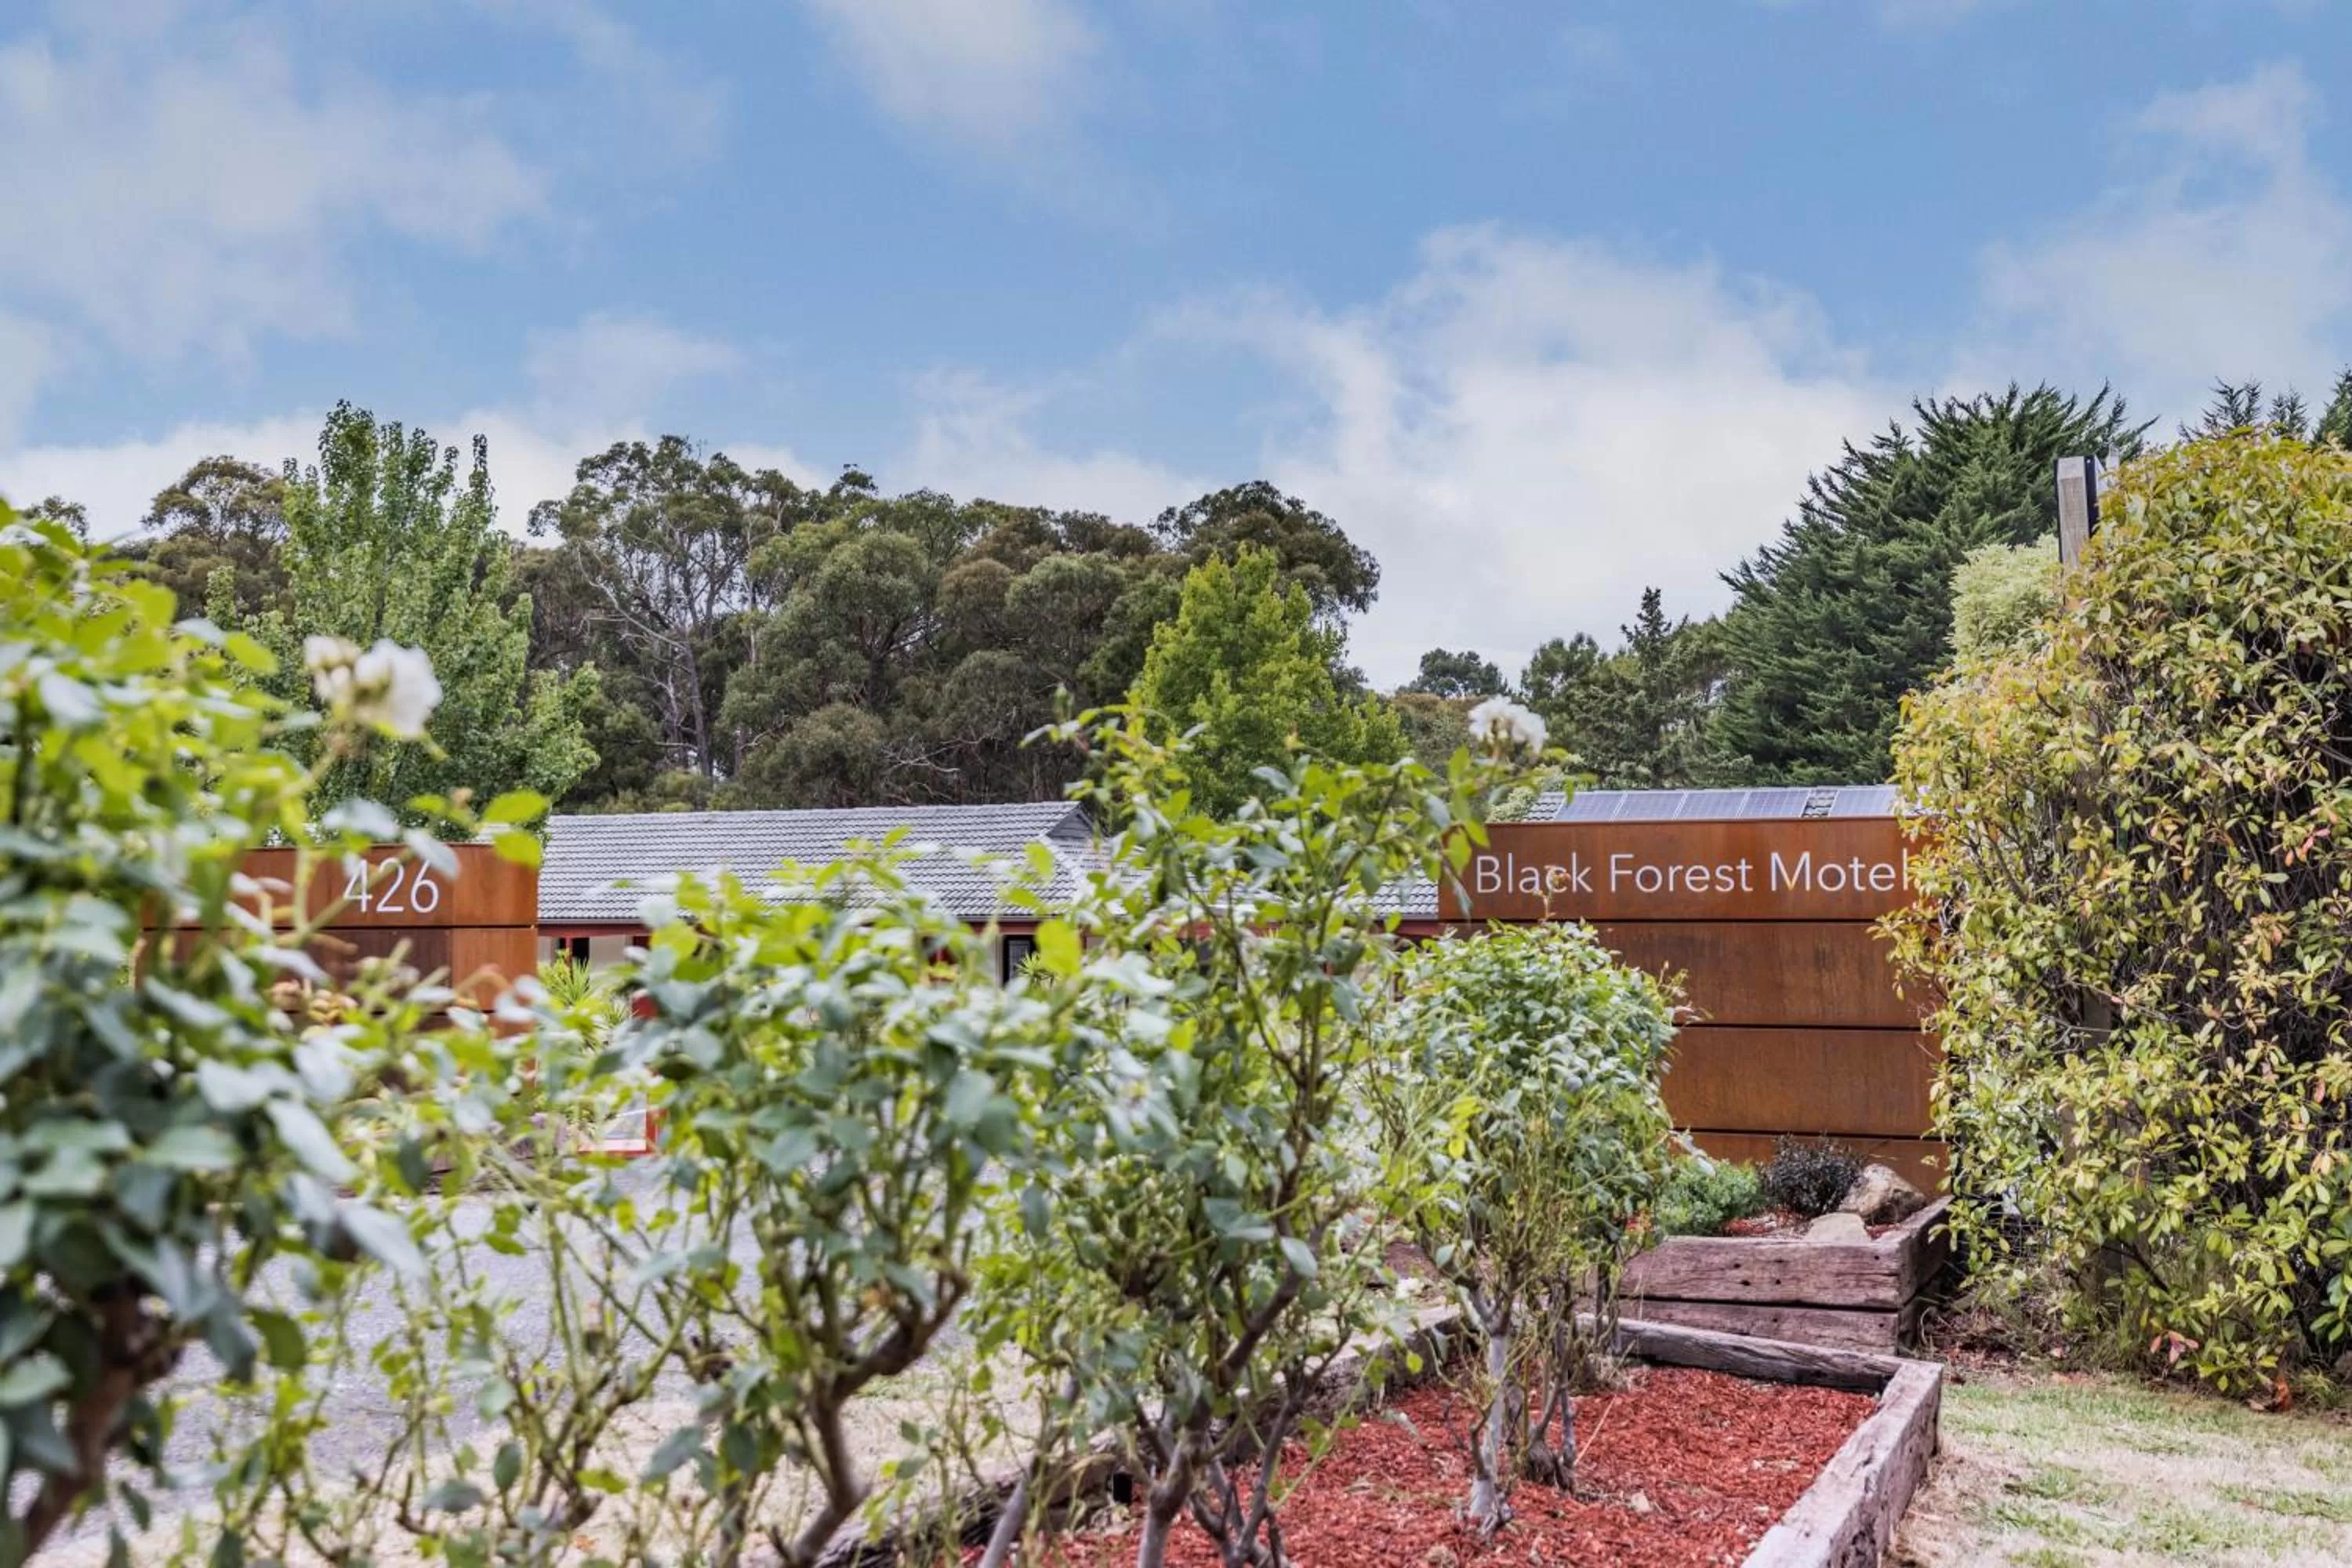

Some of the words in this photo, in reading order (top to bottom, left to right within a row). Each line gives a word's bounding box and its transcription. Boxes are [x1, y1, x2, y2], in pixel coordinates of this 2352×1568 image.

[343, 857, 439, 913] 426
[1476, 851, 1594, 894] Black
[1610, 853, 1754, 893] Forest
[1770, 848, 1909, 891] Motel
